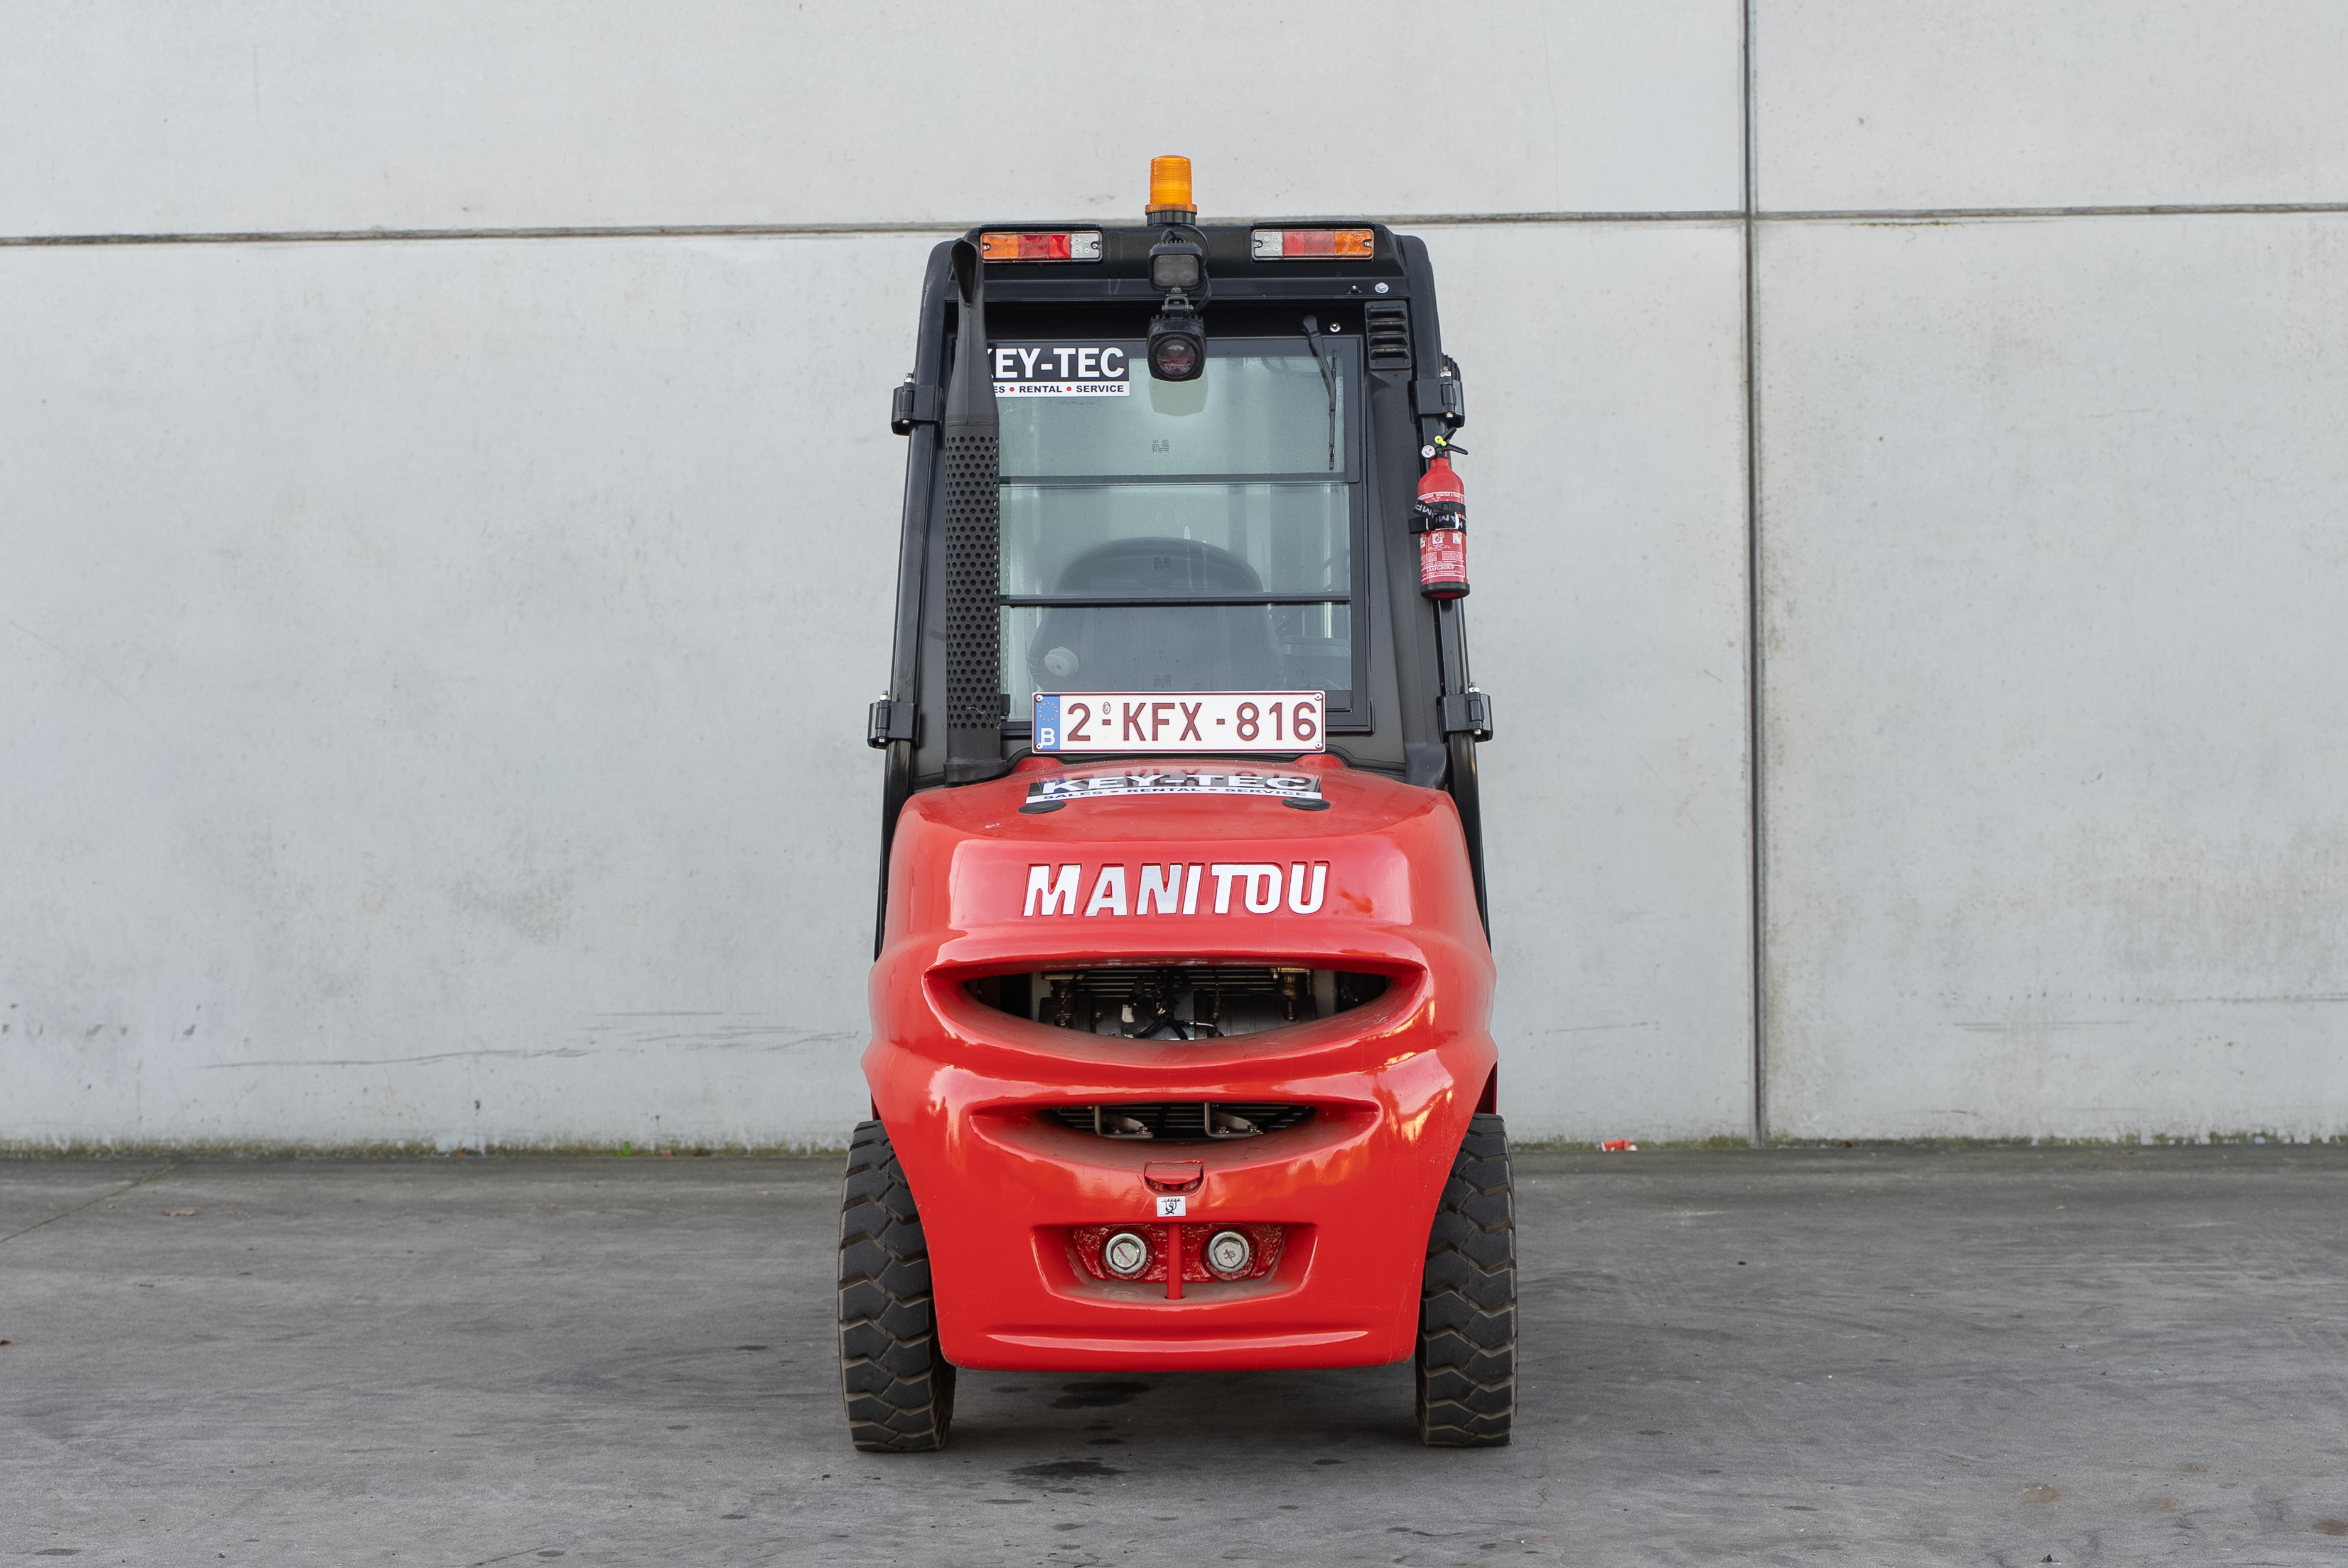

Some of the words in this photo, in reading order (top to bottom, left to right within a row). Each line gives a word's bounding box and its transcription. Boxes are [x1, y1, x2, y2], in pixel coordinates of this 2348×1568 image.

[987, 347, 1125, 379] EY-TEC
[1075, 385, 1124, 393] SERVICE
[1067, 702, 1317, 741] 2-KFX-816
[1041, 728, 1055, 746] B
[1042, 775, 1308, 795] KEY-TEC
[1043, 791, 1103, 800] SALES
[1225, 788, 1306, 797] SERVICE
[1023, 864, 1327, 917] MANITOU
